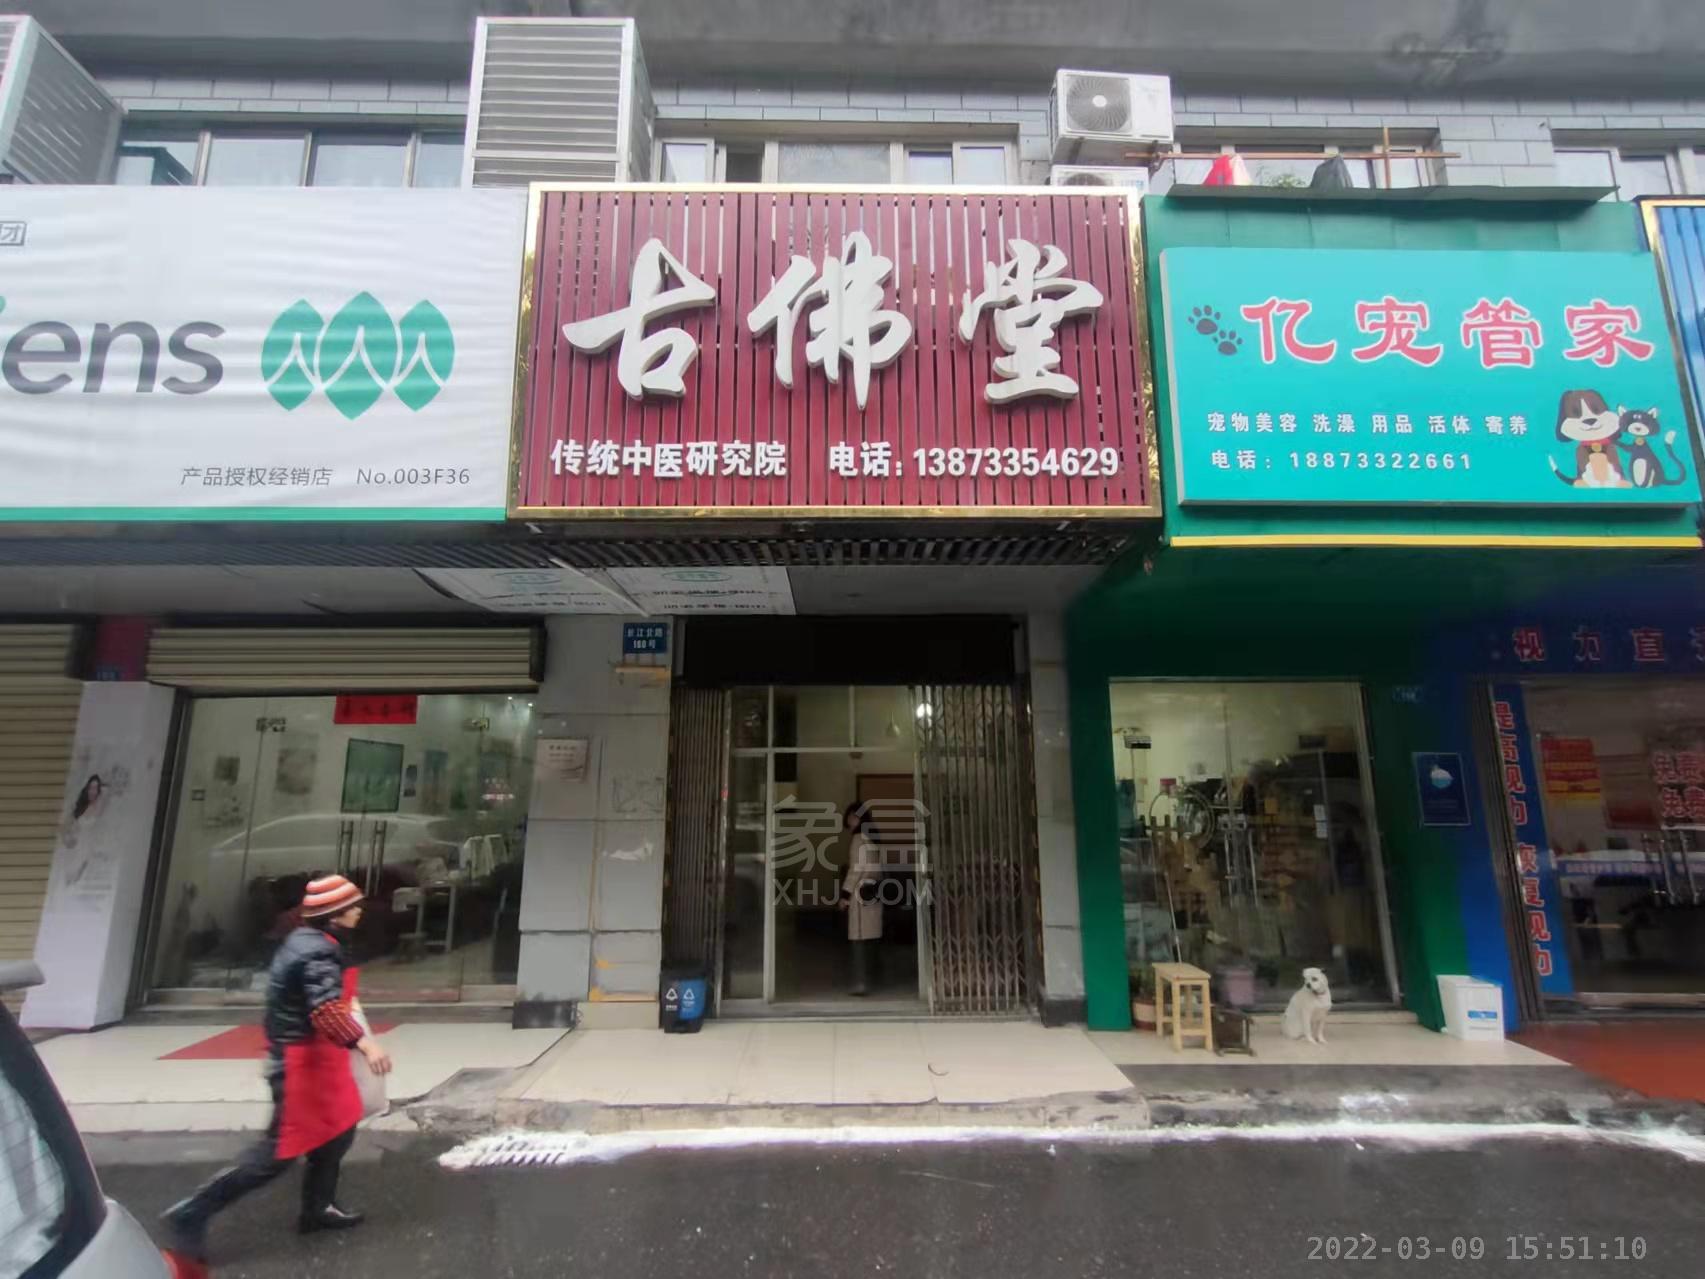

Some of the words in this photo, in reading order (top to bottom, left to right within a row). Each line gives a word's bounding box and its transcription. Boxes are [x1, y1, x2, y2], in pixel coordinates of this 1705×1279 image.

[0, 300, 226, 395] ens
[561, 231, 1104, 411] 古佛堂
[1240, 295, 1656, 370] 亿宠管家
[1207, 412, 1299, 434] 宠物美容
[1313, 412, 1357, 434] 洗澡
[1371, 413, 1414, 435] 用品
[1427, 414, 1472, 436] 活体
[1485, 415, 1529, 436] 寄养
[180, 466, 334, 488] 产品授权经销店
[357, 466, 471, 486] No.003F36
[551, 438, 788, 480] 传统中医研究院
